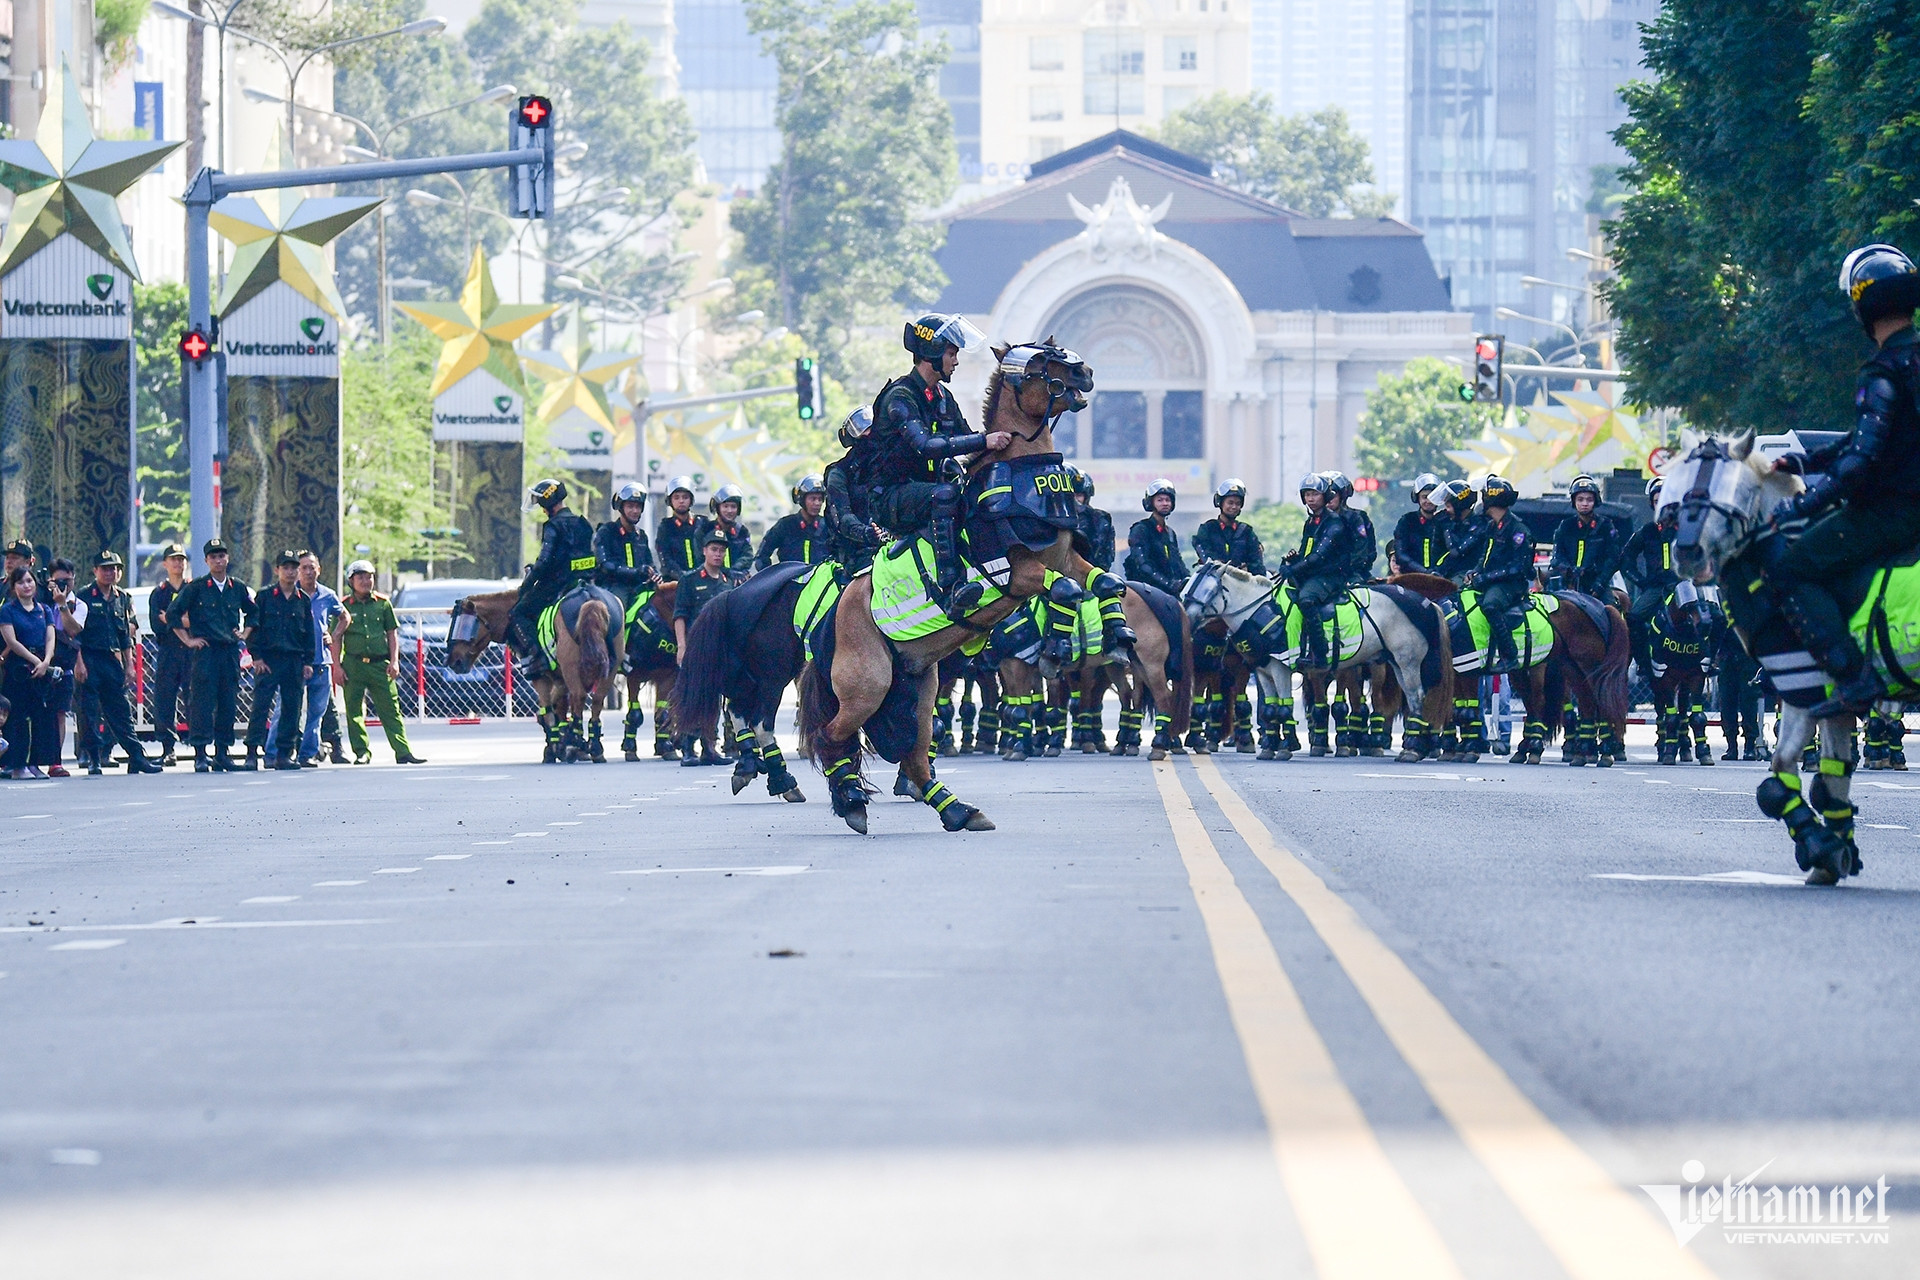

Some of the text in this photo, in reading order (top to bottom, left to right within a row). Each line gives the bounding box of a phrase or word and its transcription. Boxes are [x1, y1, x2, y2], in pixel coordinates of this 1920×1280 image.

[4, 299, 127, 316] Vietcombank
[226, 340, 336, 356] Vietcombank
[436, 413, 519, 425] Vietcombank
[1662, 637, 1700, 654] POLICE
